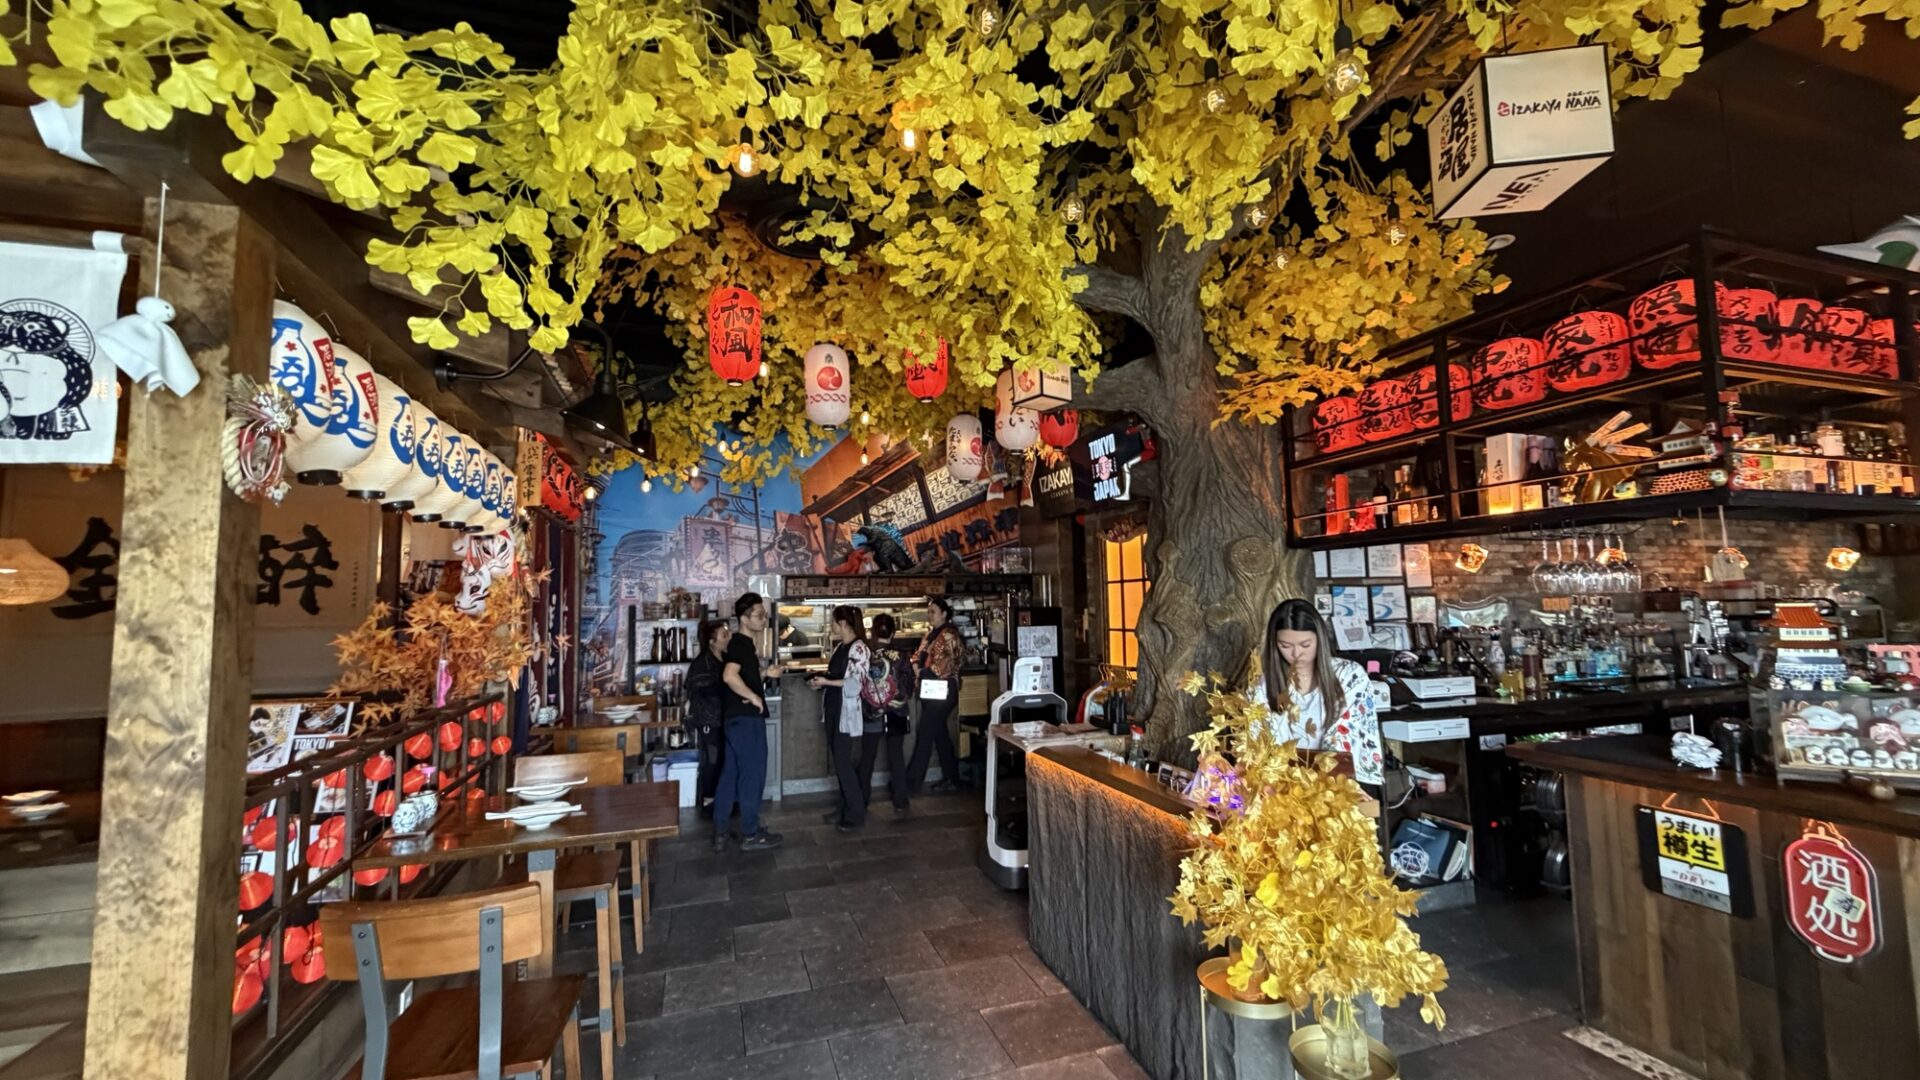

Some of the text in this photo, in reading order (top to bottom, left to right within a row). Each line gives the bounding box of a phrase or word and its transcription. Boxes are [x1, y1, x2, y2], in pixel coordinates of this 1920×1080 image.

[1512, 96, 1601, 116] IZAKAYA NANA
[1088, 433, 1116, 460] TOKYO
[295, 738, 326, 751] TOKYO
[1661, 816, 1715, 841] うまい!
[1663, 832, 1719, 866] 樽生
[1679, 873, 1706, 885] DRY
